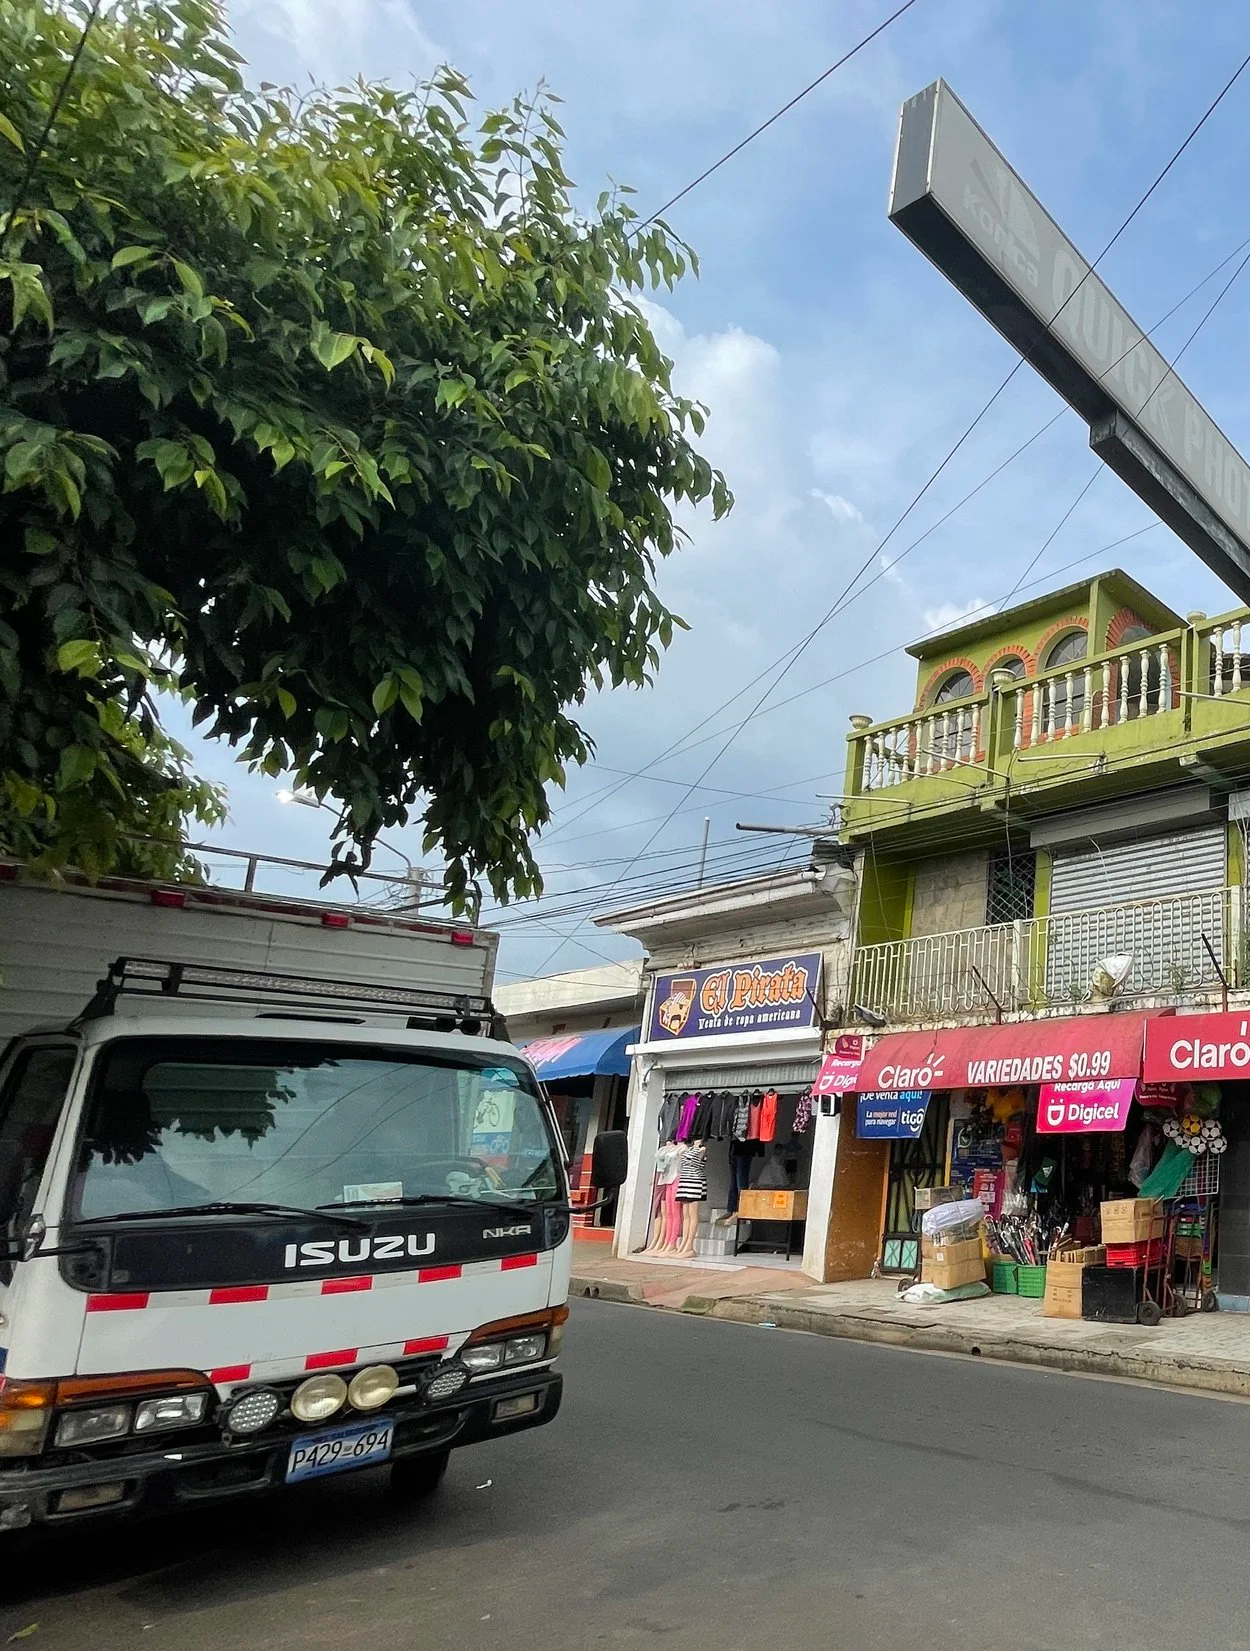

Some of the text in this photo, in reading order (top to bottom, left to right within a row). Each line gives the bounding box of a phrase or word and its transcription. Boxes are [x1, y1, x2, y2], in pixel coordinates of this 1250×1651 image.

[1052, 249, 1179, 448] QUICK
[701, 960, 809, 1016] El Pirata
[698, 1008, 801, 1030] Venta de ropa americana
[1169, 1037, 1250, 1070] Claro
[878, 1064, 932, 1089] Claro
[967, 1050, 1112, 1084] VARIEDADES $0.99
[875, 1091, 899, 1101] venta
[1054, 1081, 1095, 1094] Recarga
[901, 1108, 925, 1132] tigo
[1068, 1102, 1119, 1125] Digicel
[482, 1224, 531, 1239] NKR
[284, 1233, 436, 1268] ISUZU
[290, 1429, 390, 1473] P429-694
